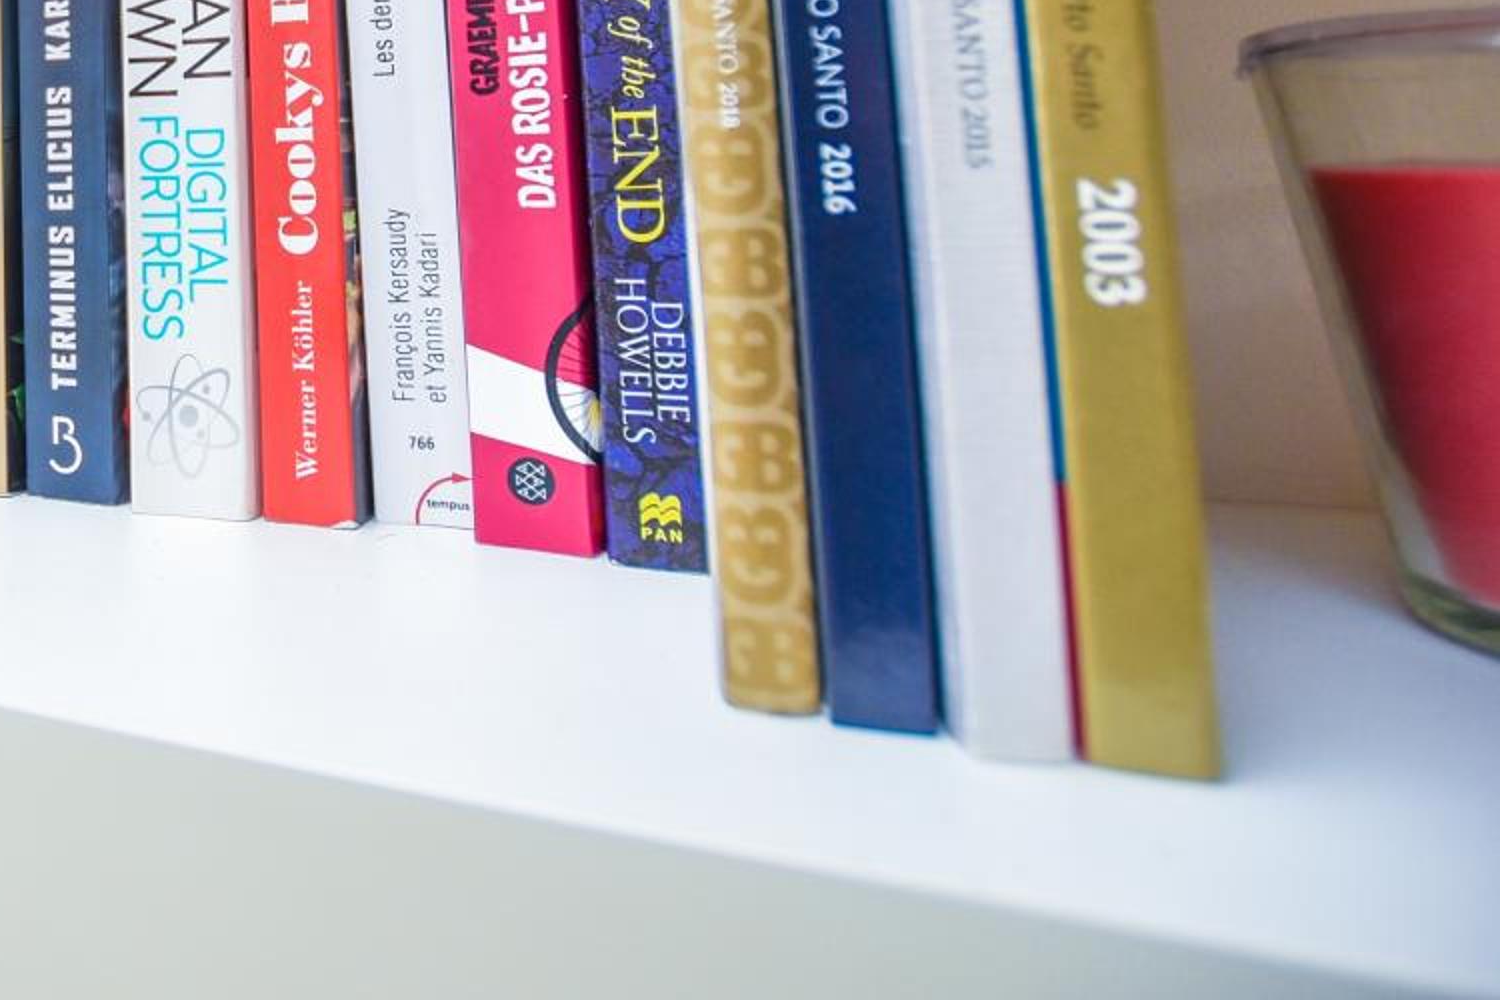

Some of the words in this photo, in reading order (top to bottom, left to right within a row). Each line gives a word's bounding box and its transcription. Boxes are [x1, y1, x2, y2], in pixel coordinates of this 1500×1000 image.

[374, 40, 395, 78] Les
[607, 15, 654, 49] of
[621, 54, 656, 99] the
[813, 24, 850, 132] SANTO
[1066, 42, 1105, 131] Santo
[45, 86, 75, 211] ELICIUS
[276, 42, 325, 257] Cookys
[515, 142, 557, 209] DAS
[610, 103, 667, 244] END
[819, 143, 858, 217] 2016
[138, 115, 185, 342] FORTRESS
[185, 128, 230, 303] DIGITAL
[383, 208, 411, 304] Kersaudy
[1075, 177, 1147, 309] 2003
[47, 225, 78, 392] TERMINUS
[414, 232, 440, 299] Kadari
[290, 280, 316, 373] Köhler
[389, 311, 415, 402] François
[419, 306, 447, 377] Yannis
[614, 277, 656, 445] HOWELLS
[651, 301, 691, 424] DEBBIE
[295, 380, 319, 480] Werner
[428, 385, 447, 404] et
[408, 435, 435, 451] 766
[426, 498, 471, 513] tempus
[639, 527, 684, 545] PAN
